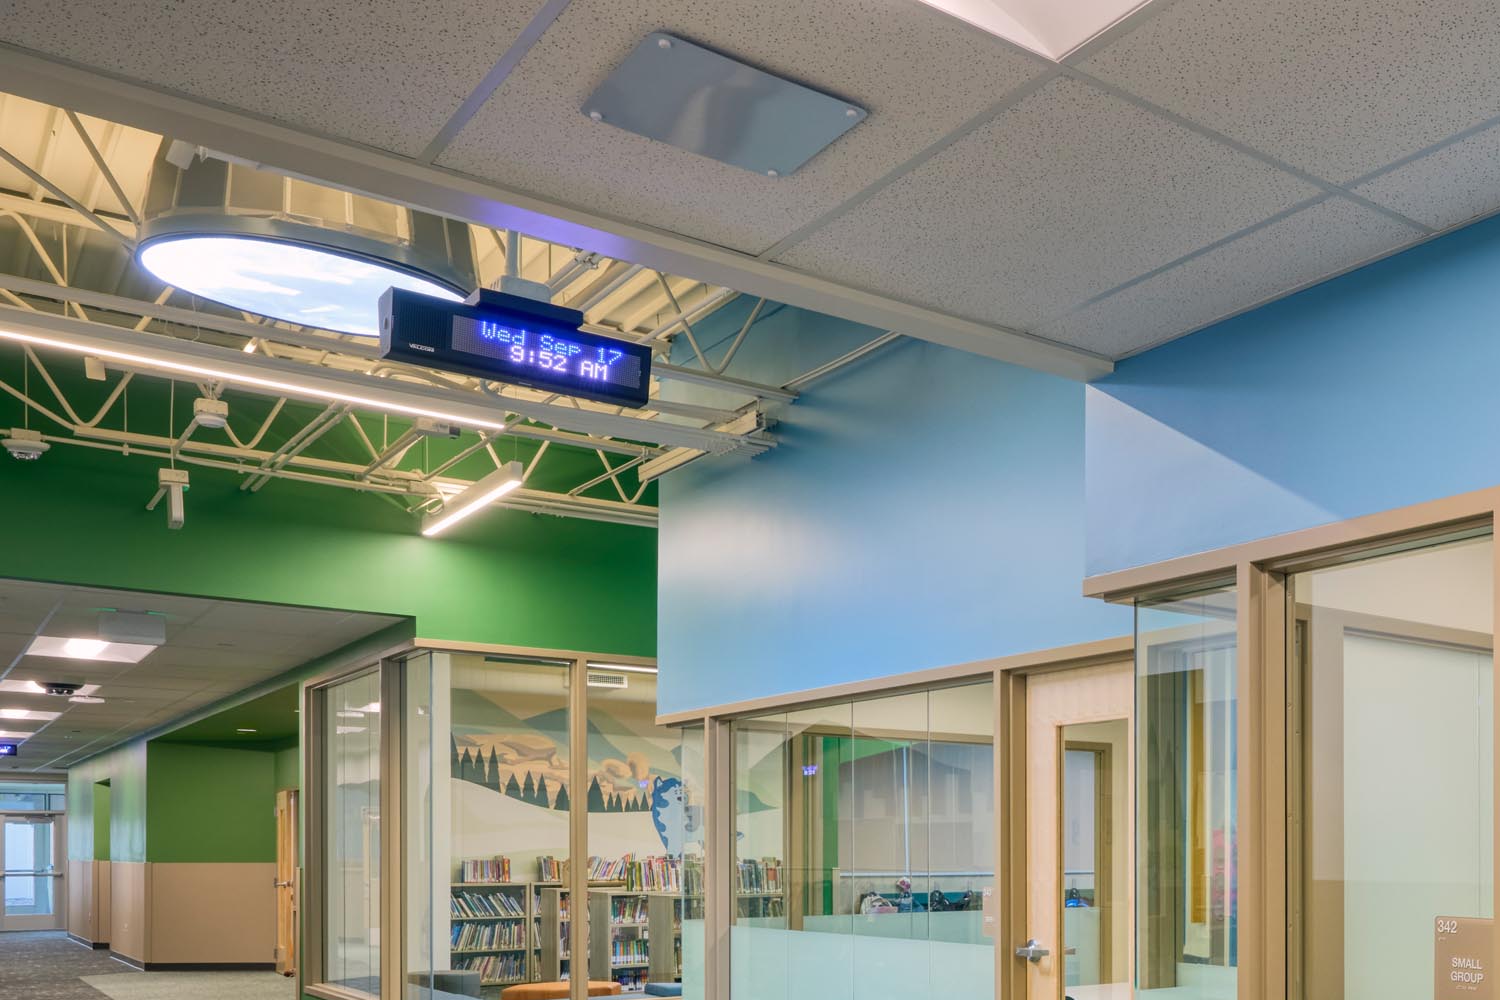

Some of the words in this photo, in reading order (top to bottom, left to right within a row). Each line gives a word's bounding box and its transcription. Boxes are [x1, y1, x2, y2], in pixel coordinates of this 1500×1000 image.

[481, 320, 525, 346] Wed
[540, 334, 581, 356] Sep
[597, 347, 624, 365] 17
[510, 345, 567, 372] 9:52
[580, 360, 608, 380] AM
[1437, 919, 1457, 934] 342
[1451, 957, 1483, 970] SMALL
[1450, 971, 1484, 984] GROUP
